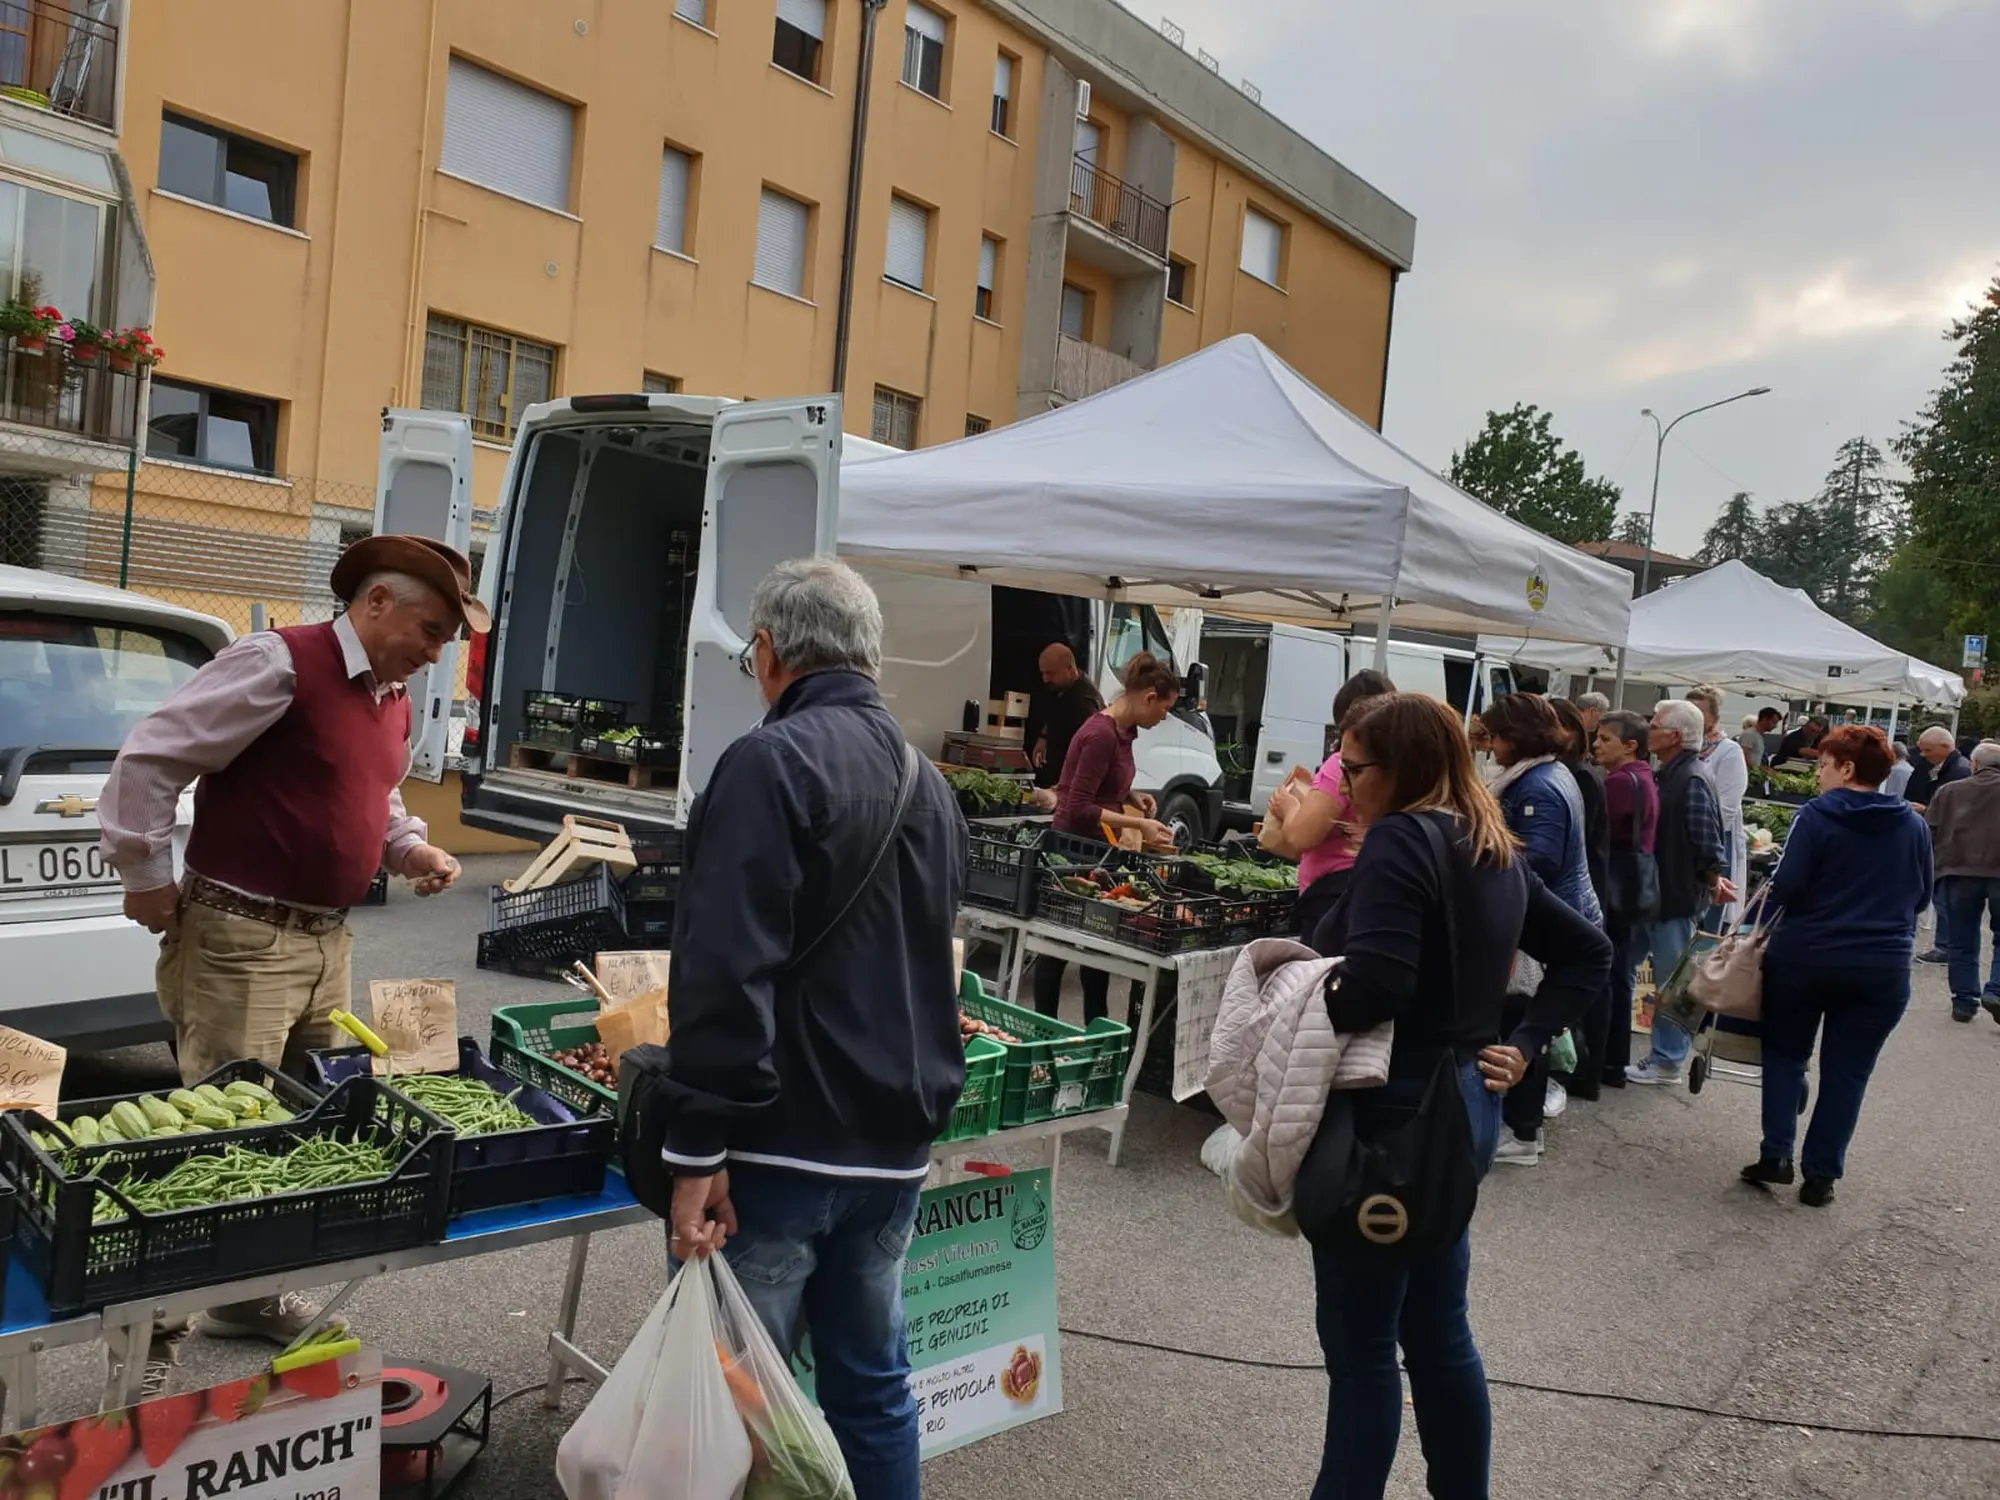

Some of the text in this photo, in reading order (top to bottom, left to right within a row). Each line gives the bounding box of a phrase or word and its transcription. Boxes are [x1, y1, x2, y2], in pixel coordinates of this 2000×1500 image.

[39, 846, 119, 882] 060
[923, 1278, 931, 1292] 4
[937, 1260, 1013, 1289] Casalfiumanese
[927, 1298, 988, 1329] PROPRIA
[991, 1290, 1010, 1311] DI
[927, 1317, 989, 1351] GENUINI
[930, 1373, 996, 1411] PENDOLA
[925, 1416, 947, 1436] RIO
[184, 1416, 373, 1500] RANCH"
